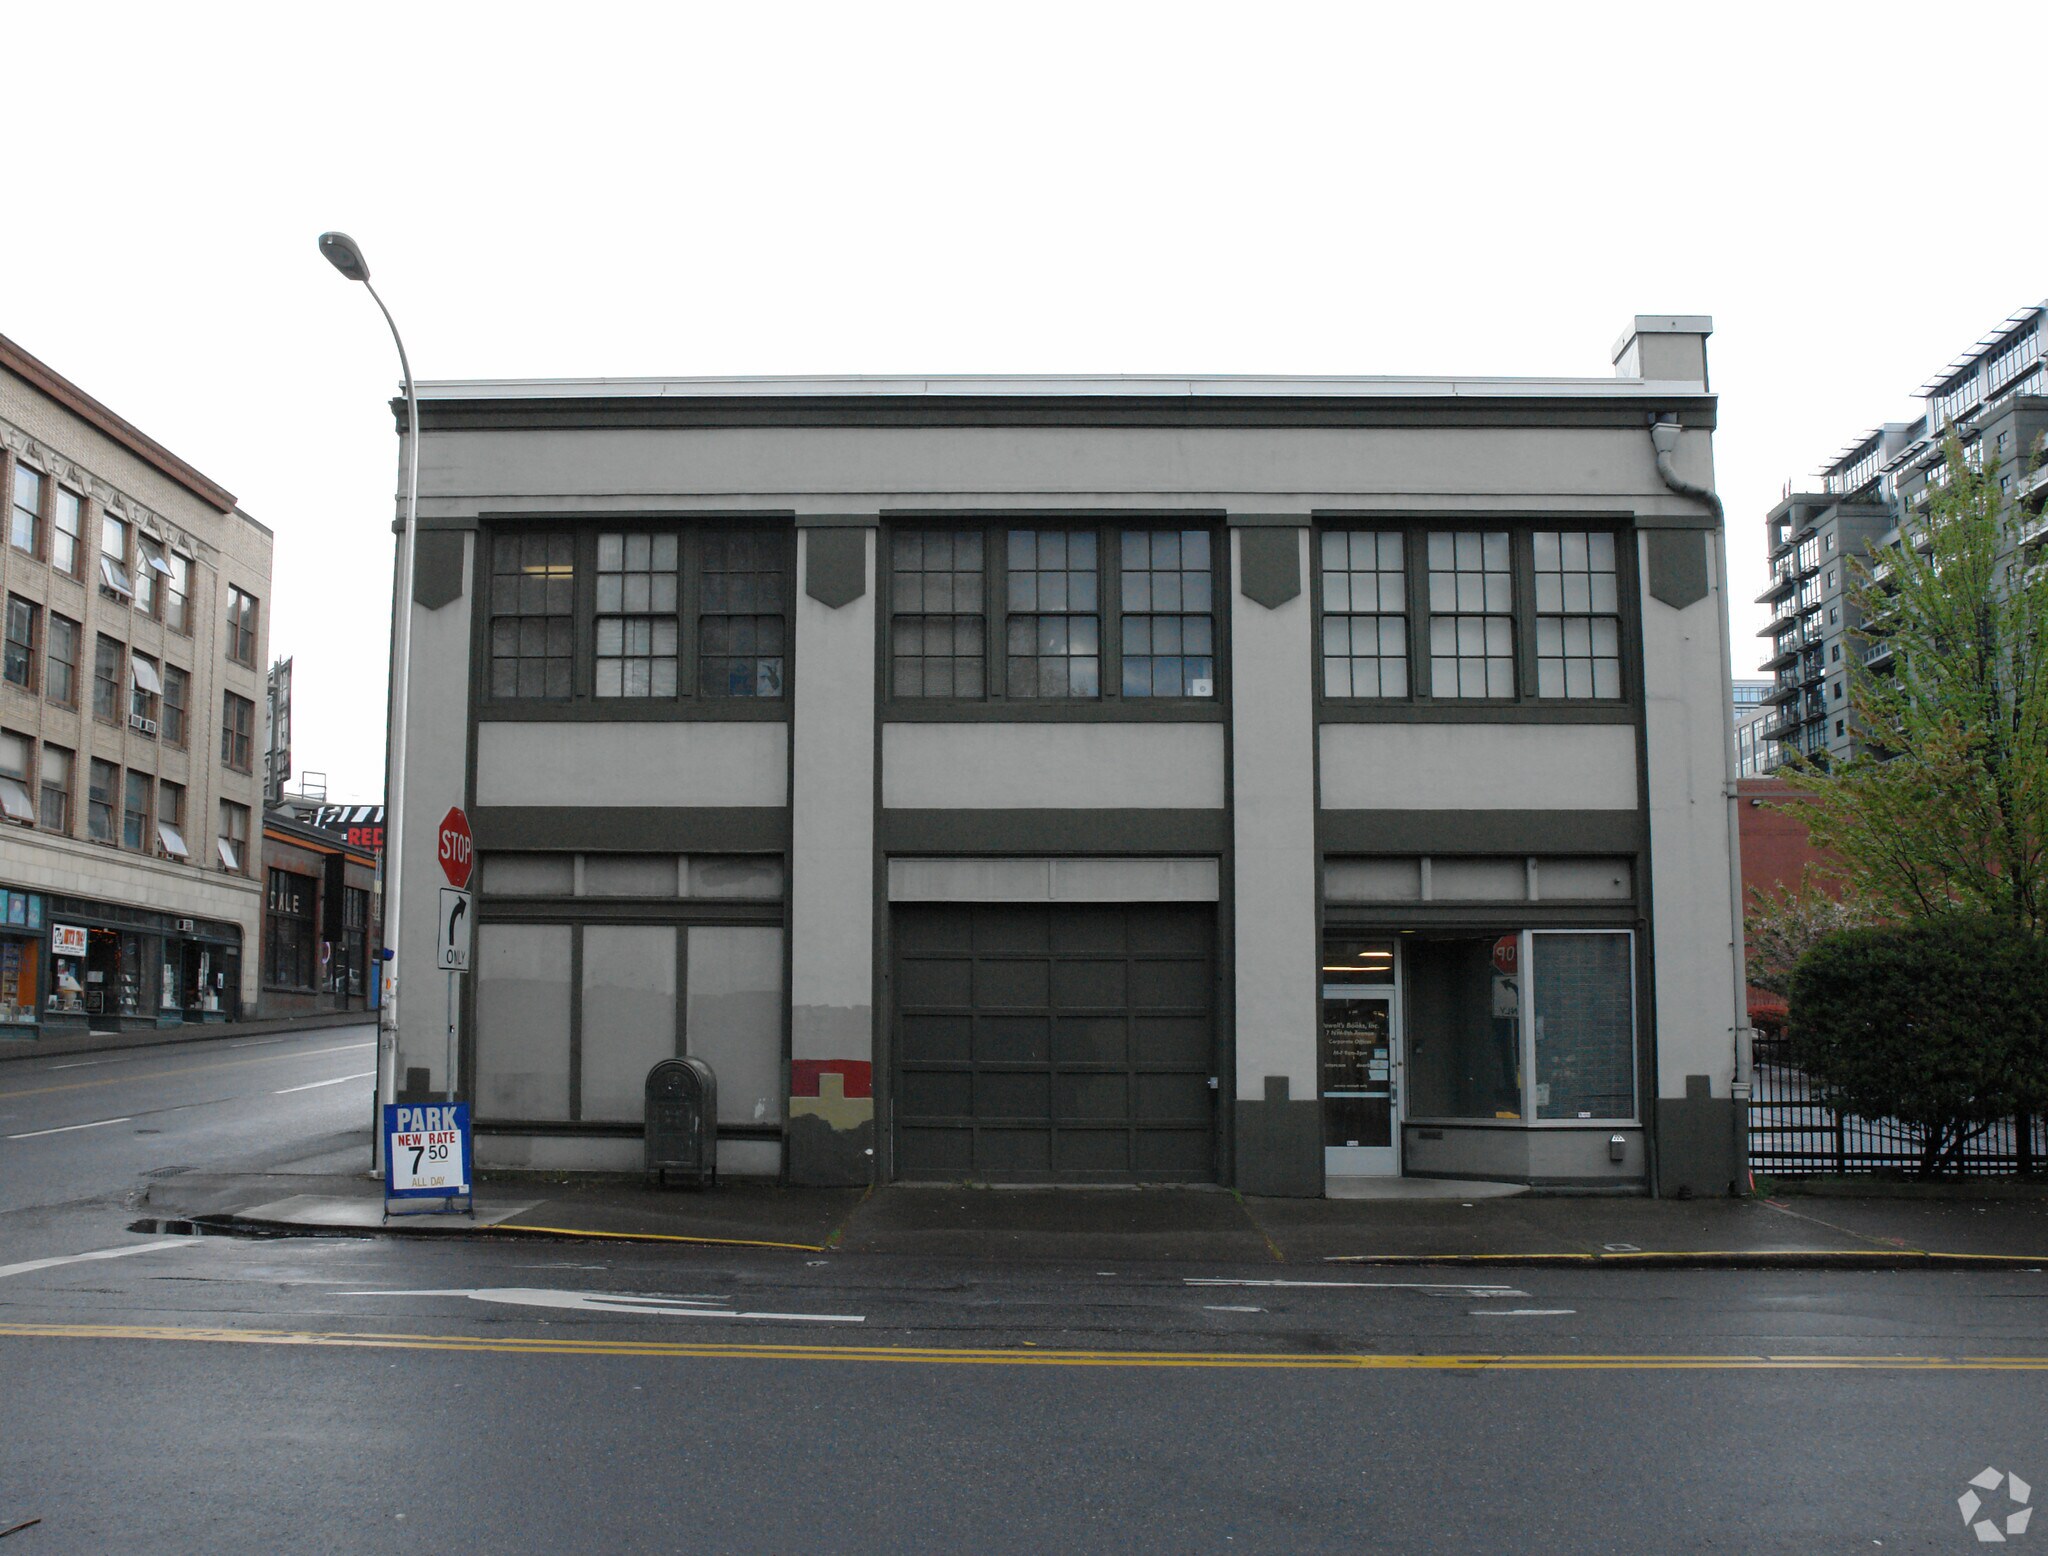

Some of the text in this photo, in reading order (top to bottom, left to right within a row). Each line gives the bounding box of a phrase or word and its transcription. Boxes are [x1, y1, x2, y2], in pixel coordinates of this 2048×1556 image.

[441, 829, 471, 865] STOP
[270, 890, 299, 913] SALE
[446, 949, 466, 965] ONLY
[397, 1106, 458, 1132] PARK
[398, 1131, 456, 1146] NEW RATE
[411, 1176, 445, 1187] ALL DAY
